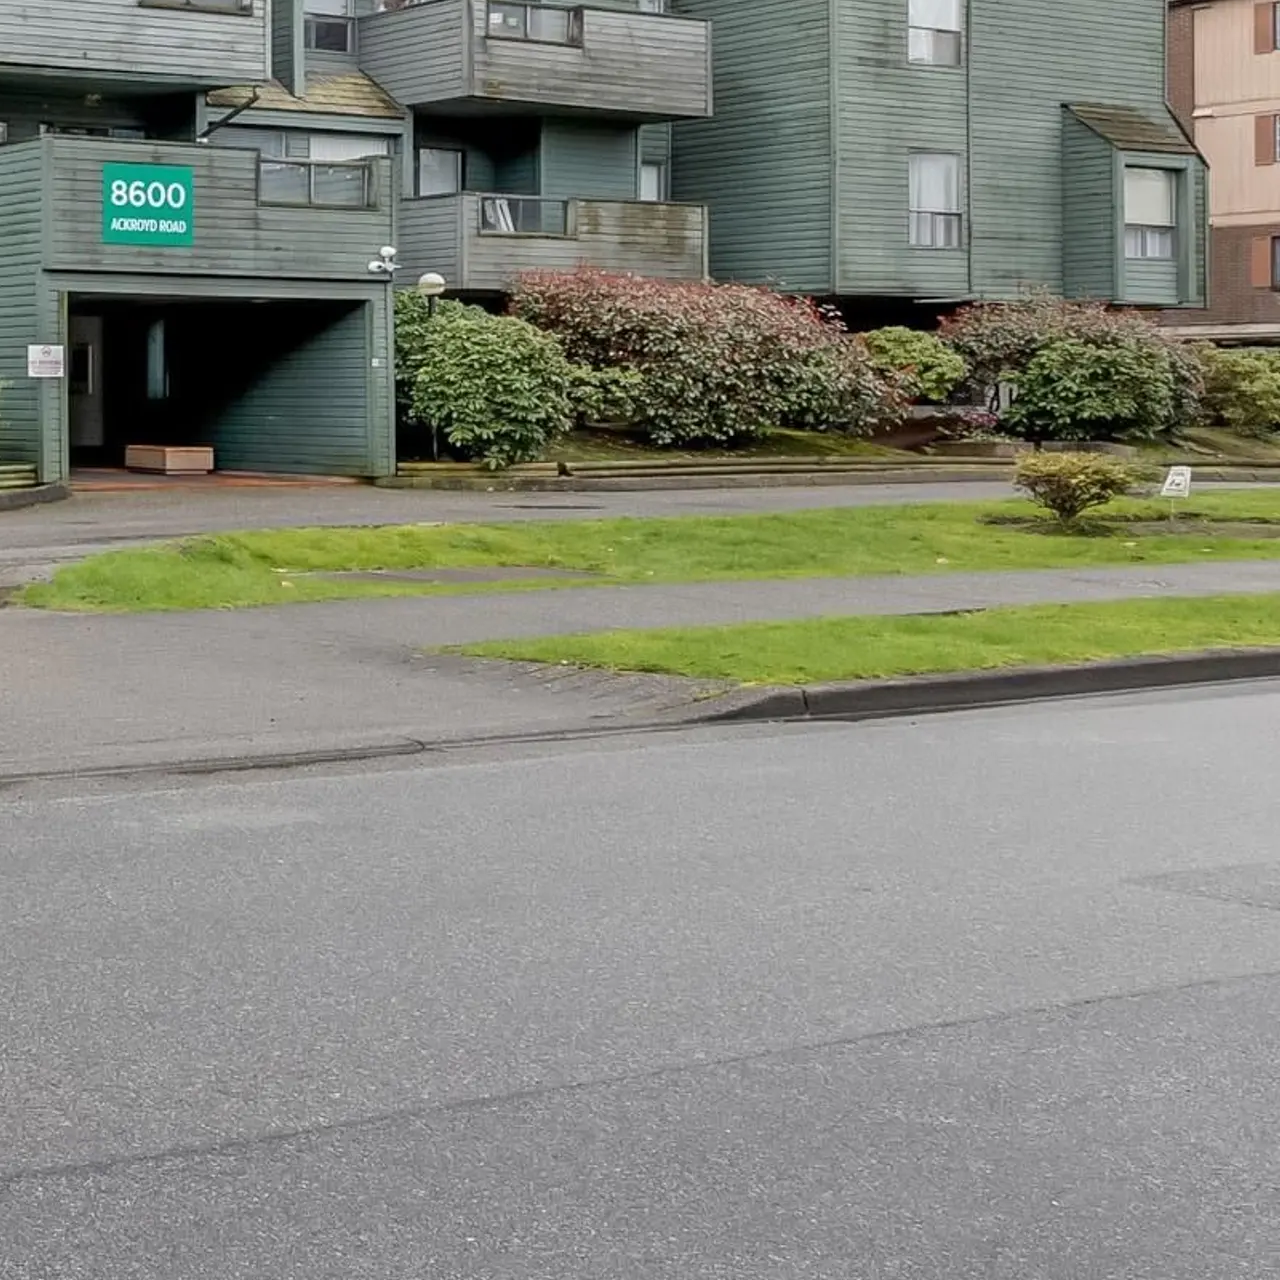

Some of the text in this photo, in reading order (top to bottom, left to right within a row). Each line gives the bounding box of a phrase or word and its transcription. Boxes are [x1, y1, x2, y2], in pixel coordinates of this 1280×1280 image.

[111, 179, 186, 209] 8600
[110, 217, 187, 234] ACKROYD ROAD
